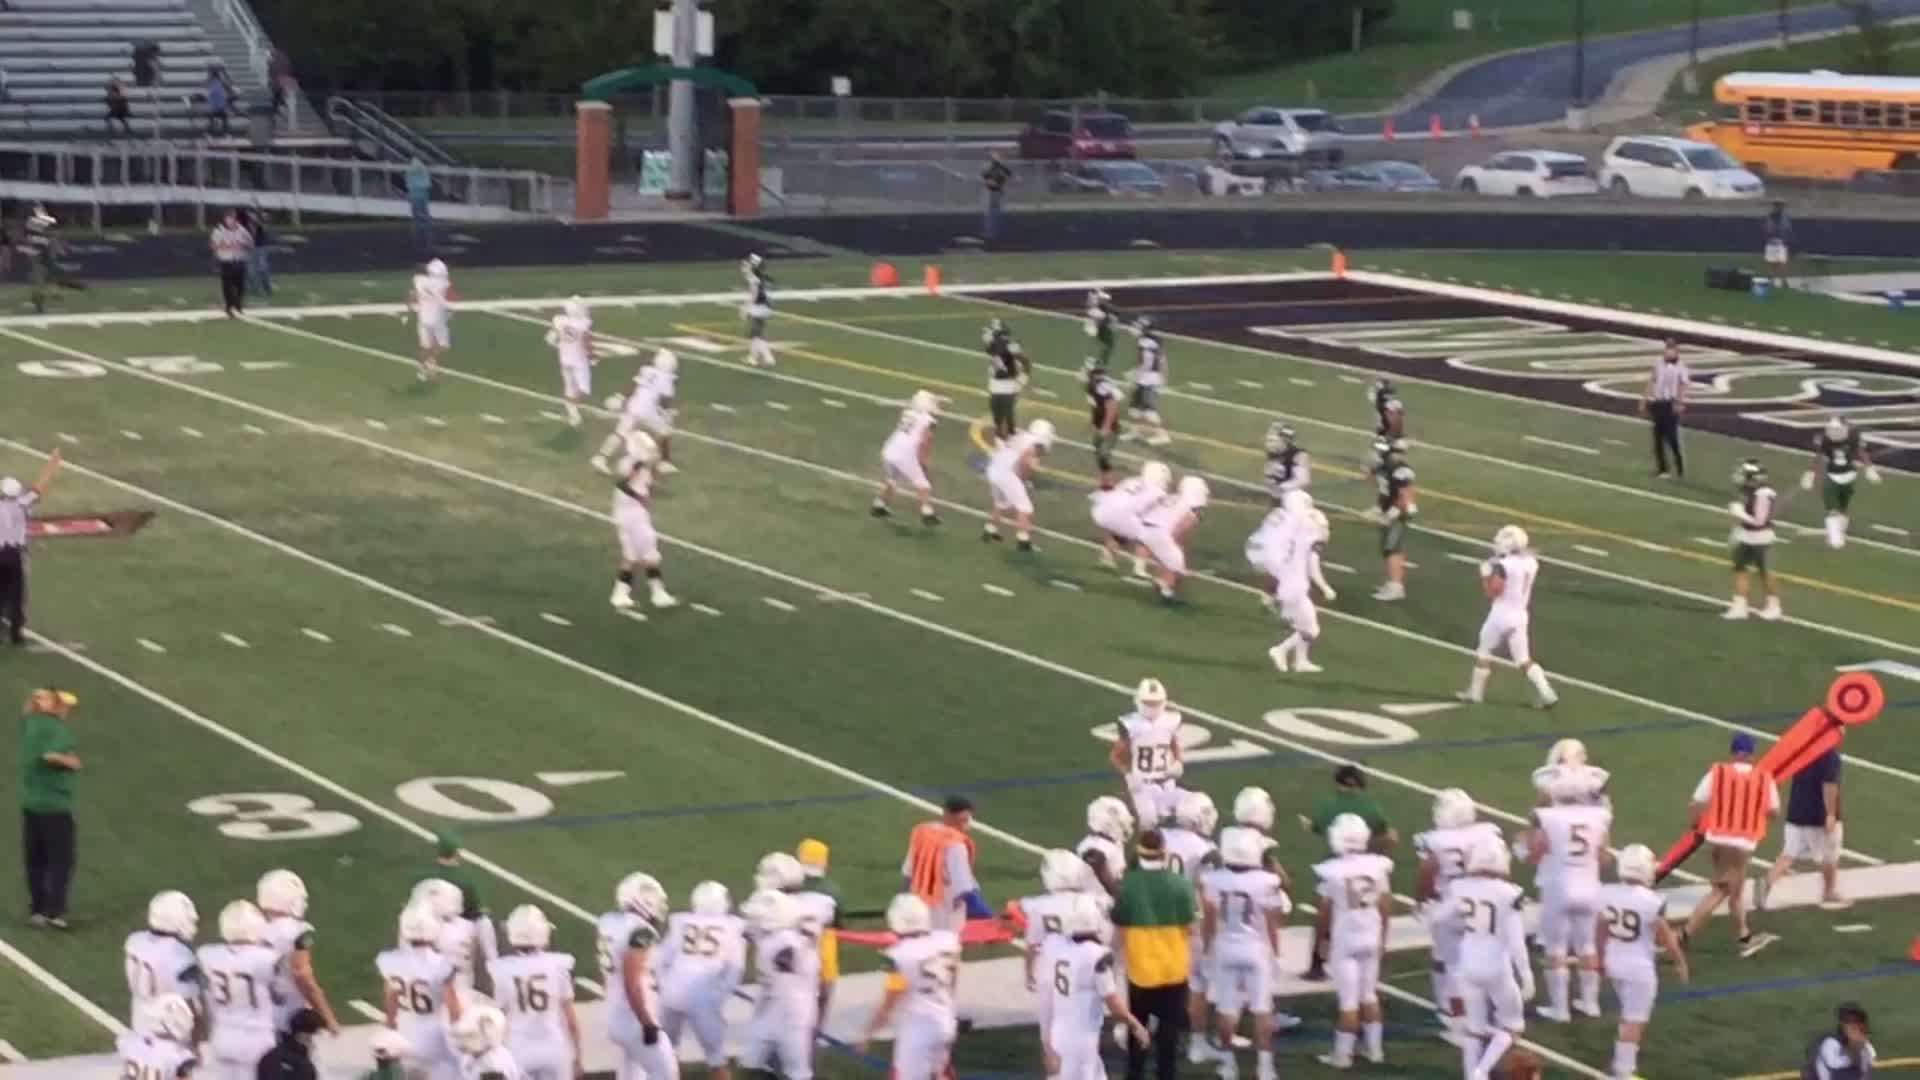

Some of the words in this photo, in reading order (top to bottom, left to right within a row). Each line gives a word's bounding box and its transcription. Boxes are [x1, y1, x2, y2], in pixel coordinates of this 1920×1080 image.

[1137, 743, 1168, 773] 83
[187, 776, 553, 840] 30
[1569, 823, 1588, 857] 5
[1345, 874, 1376, 909] 12
[1461, 897, 1496, 934] 27
[1604, 904, 1641, 943] 29
[682, 923, 721, 958] 85
[211, 970, 258, 1010] 37
[388, 975, 433, 1015] 26
[513, 973, 549, 1013] 16
[1055, 960, 1071, 998] 6
